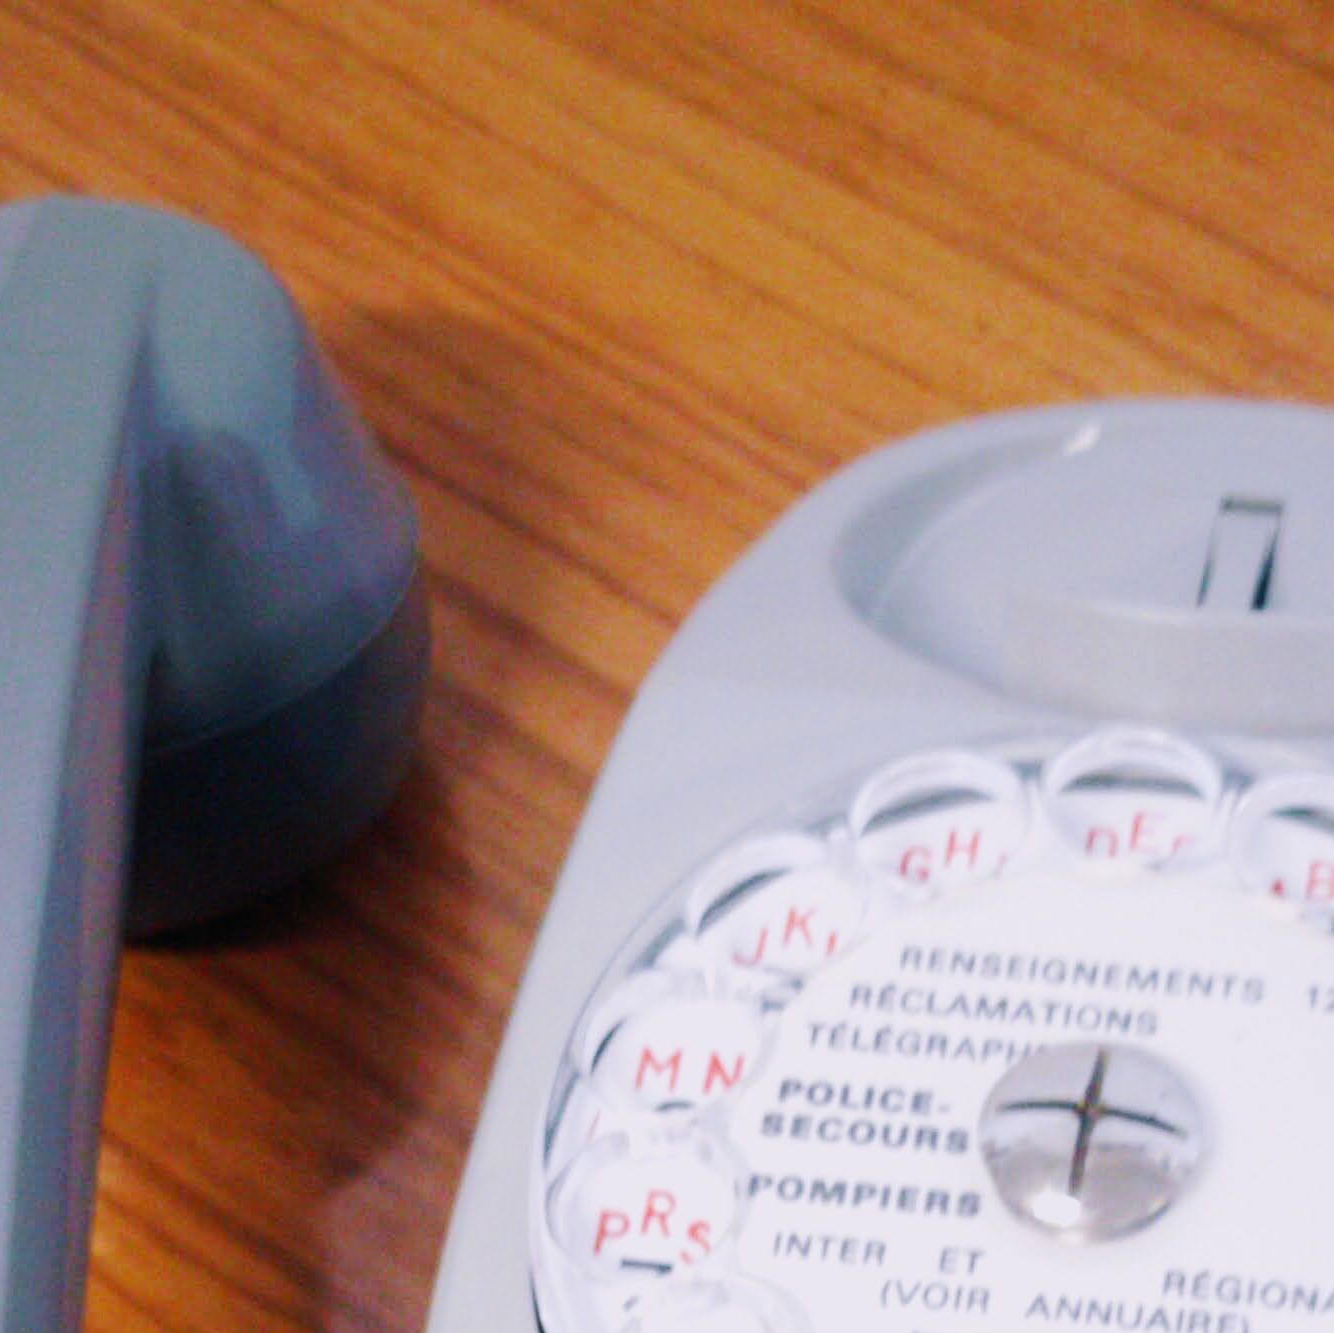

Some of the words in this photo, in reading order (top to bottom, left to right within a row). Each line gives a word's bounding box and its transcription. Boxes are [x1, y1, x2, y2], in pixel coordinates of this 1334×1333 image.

[899, 945, 1266, 1004] RENSEIGNEMENTS
[849, 982, 1158, 1036] RÉCLAMATIONS
[759, 1112, 971, 1154] SECOURS
[746, 1171, 983, 1219] POMPIERS
[772, 1230, 888, 1266] INTER
[937, 1247, 987, 1275] ET
[879, 1277, 991, 1315] (VOIR
